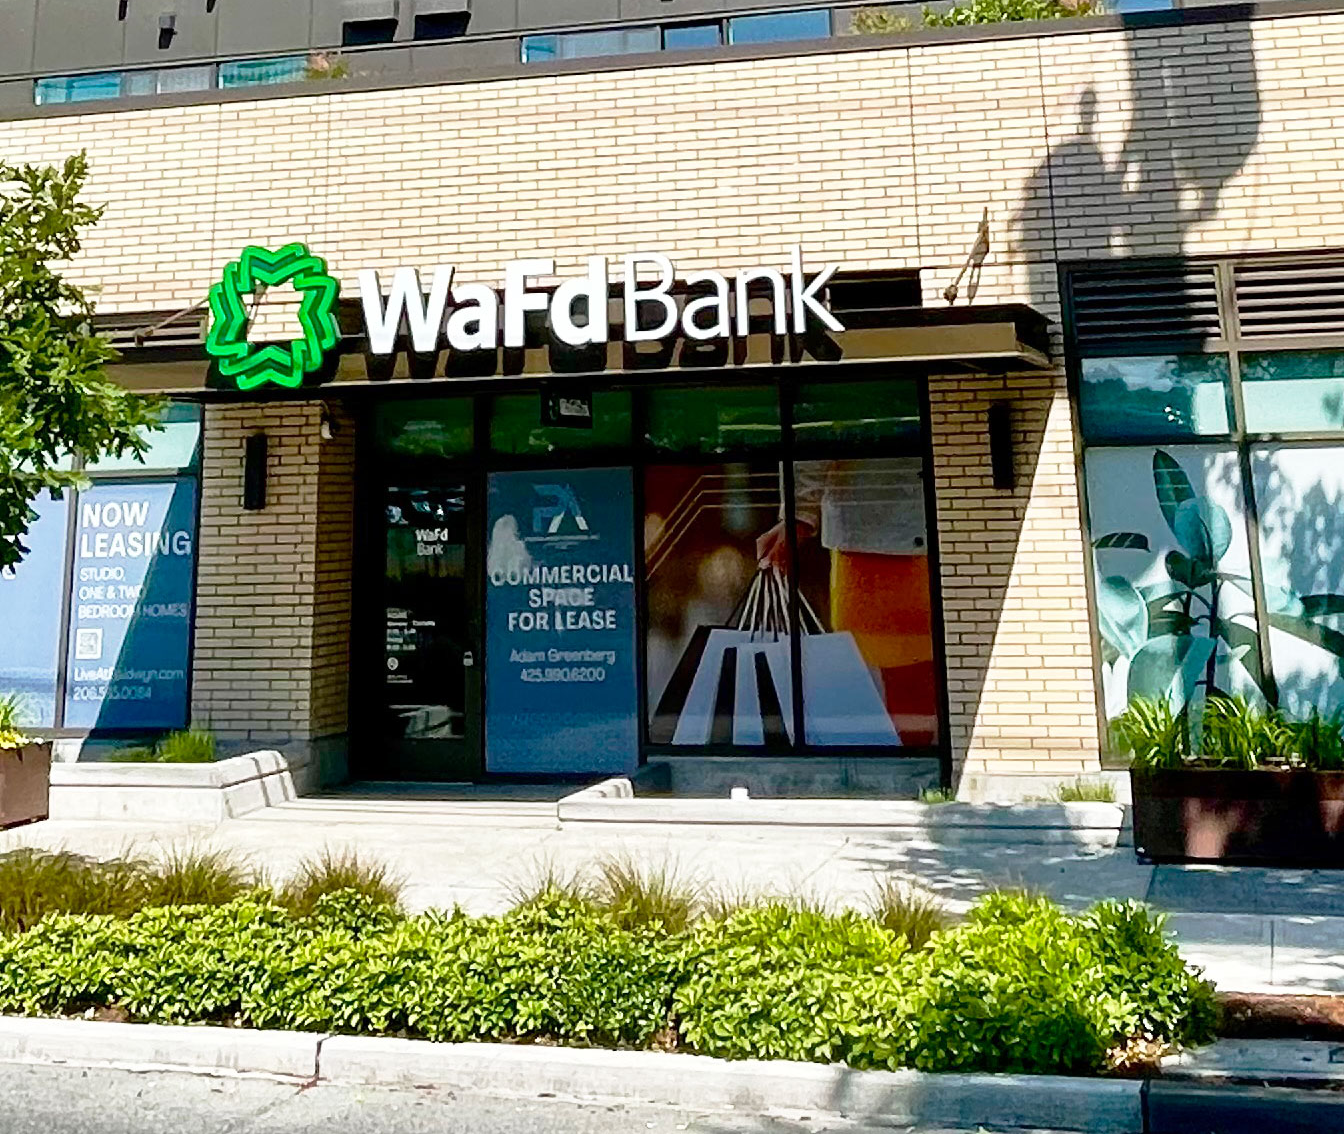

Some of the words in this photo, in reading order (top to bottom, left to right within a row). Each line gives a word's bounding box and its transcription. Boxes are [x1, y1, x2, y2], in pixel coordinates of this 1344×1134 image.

[82, 501, 149, 528] NOW
[80, 530, 192, 558] LEASING
[415, 528, 449, 542] WaFd
[417, 542, 444, 556] Bank
[490, 564, 634, 586] COMMERCIAL
[79, 586, 105, 600] ONE
[119, 585, 143, 599] TW
[528, 587, 595, 608] SPACE
[508, 612, 550, 632] FOR
[555, 610, 617, 631] LEASE
